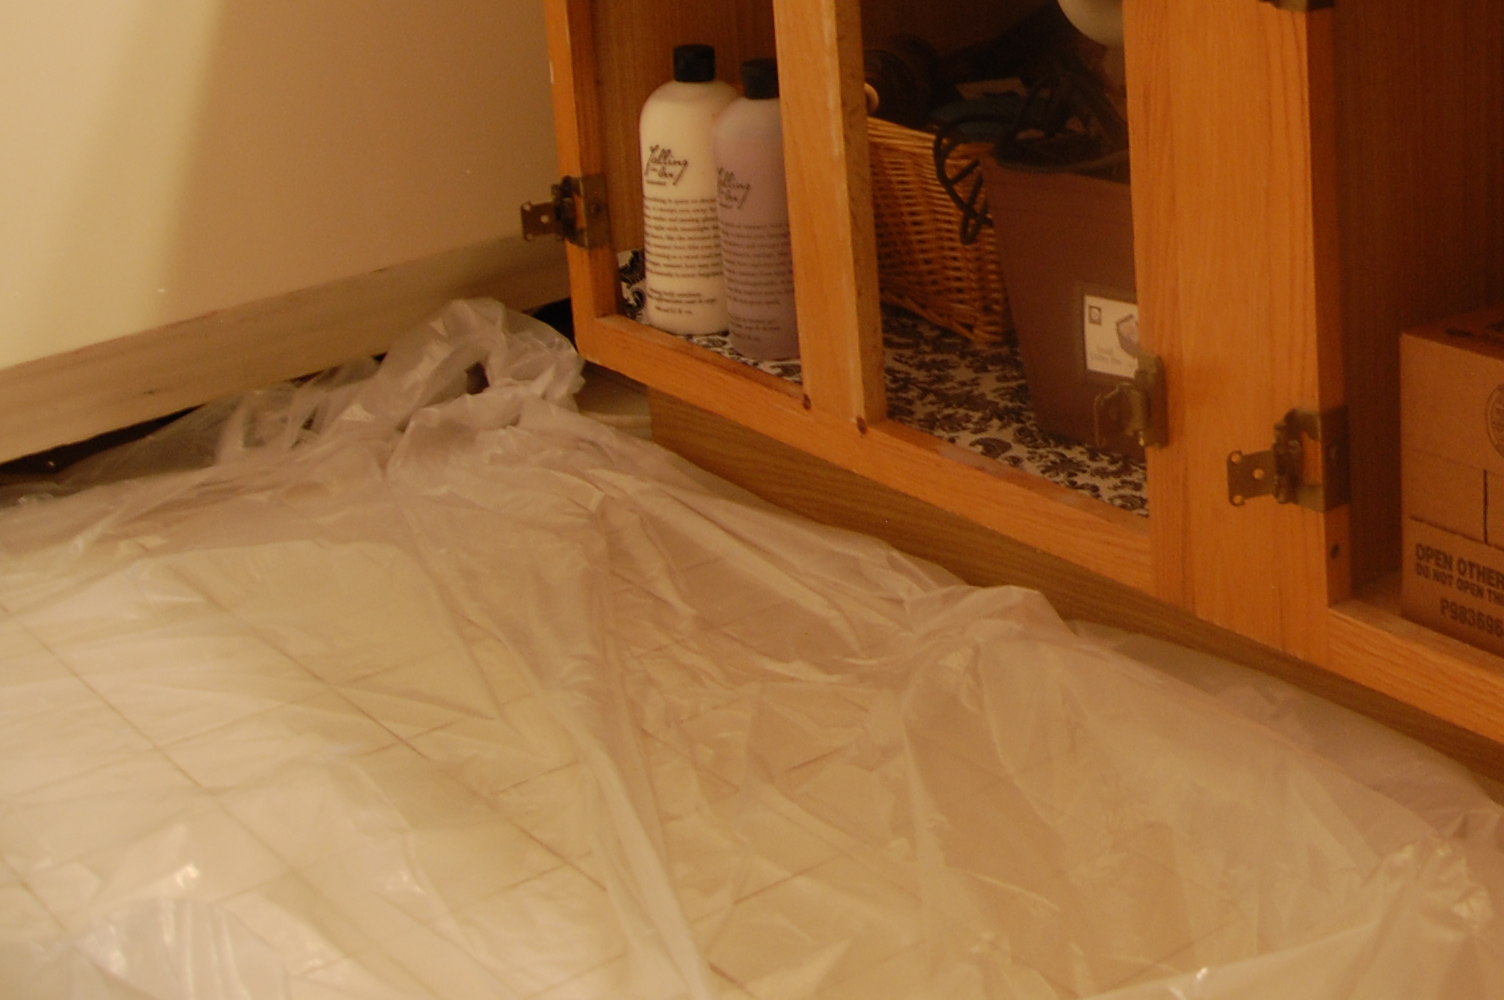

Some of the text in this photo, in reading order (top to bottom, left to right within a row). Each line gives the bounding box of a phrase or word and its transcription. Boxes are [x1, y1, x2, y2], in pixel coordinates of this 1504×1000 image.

[1415, 542, 1453, 571] OPEN
[1457, 557, 1504, 592] OTHER
[1415, 562, 1430, 579] DO
[1432, 568, 1453, 587] NOT
[1456, 578, 1484, 599] OPEN
